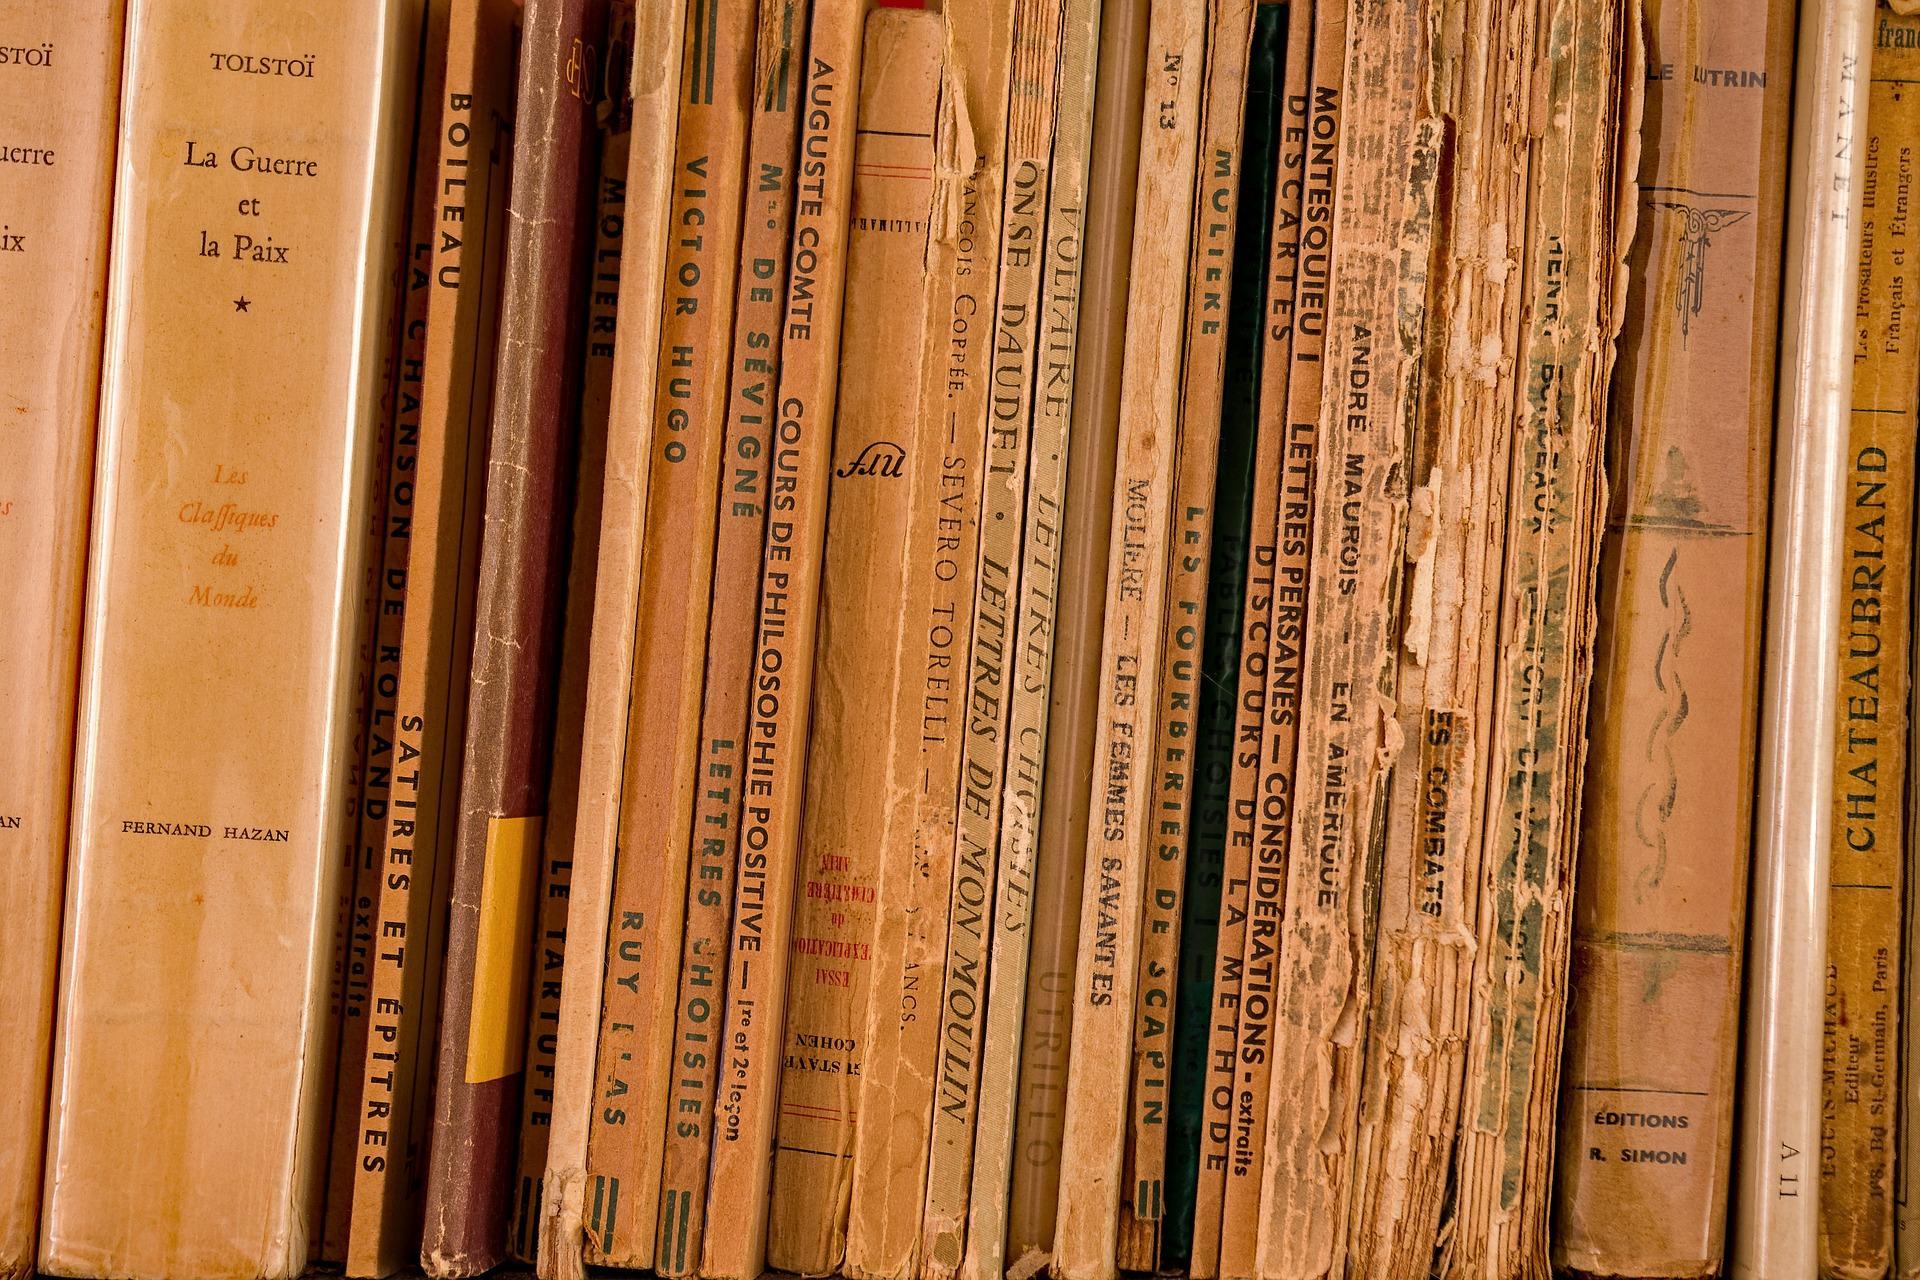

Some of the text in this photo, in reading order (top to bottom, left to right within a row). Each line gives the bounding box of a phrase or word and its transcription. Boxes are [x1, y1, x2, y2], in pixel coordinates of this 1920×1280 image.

[210, 53, 316, 78] TOLSTOÏ
[1647, 63, 1767, 88] LE LUTRIN
[1877, 18, 1920, 48] fran
[184, 141, 318, 177] La Guerre
[1159, 100, 1176, 130] 13
[1831, 53, 1858, 230] MANET
[199, 230, 289, 263] la Paix
[238, 197, 260, 216] et
[438, 93, 473, 289] BOILEAU
[789, 57, 834, 341] AUGUSTE COMTE
[1270, 94, 1309, 342] DESCARTES
[1299, 86, 1339, 336] MONTESQUIEU
[1885, 147, 1912, 355] Français et Étrangers
[411, 243, 432, 292] LA
[664, 156, 708, 464] VICTOR HUGO
[751, 258, 776, 303] DE
[390, 319, 427, 540] CHANSON
[732, 331, 775, 517] SÉVIGNÉ
[989, 303, 1027, 475] DAUDET
[213, 464, 248, 485] Les
[773, 397, 804, 512] COURS
[1282, 423, 1314, 556] LETTRES
[211, 544, 239, 567] du
[769, 522, 793, 562] DE
[935, 456, 966, 582] SEVERO
[1182, 506, 1205, 574] LES
[1338, 453, 1365, 597] MAUROIS
[190, 585, 259, 608] Monde
[383, 568, 407, 617] DE
[970, 555, 1010, 743] LETTRES
[1271, 566, 1305, 727] PERSANES
[1846, 445, 1888, 852] CHATEAUBRIAND
[750, 572, 789, 797] PHILOSOPHIE
[922, 602, 955, 753] TORELLI.
[1112, 654, 1139, 708] LES
[1237, 544, 1276, 770] DISCOURS
[366, 645, 401, 820] ROLAND
[963, 758, 994, 821] DE
[1103, 720, 1134, 843] FEMMES
[1158, 600, 1198, 862] FOURBERIES
[122, 821, 290, 842] FERNAND HAZAN
[698, 739, 734, 908] LETTRES
[739, 807, 771, 952] POSITIVE
[1232, 798, 1256, 848] DE
[1421, 766, 1449, 918] COMBATS
[363, 715, 424, 1173] SATIRES ET ÉPÎTRES
[955, 835, 988, 939] MON
[1089, 857, 1123, 1008] SAVANTES
[1152, 888, 1177, 935] DE
[1225, 877, 1249, 927] LA
[1241, 772, 1287, 1066] CONSIDÉRATIONS
[347, 895, 371, 1019] extraits
[617, 911, 644, 994] RUY
[815, 969, 849, 987] ESSAI
[1871, 947, 1889, 993] Paris
[734, 1032, 752, 1054] et
[796, 1034, 855, 1052] COHEN
[941, 950, 979, 1124] MOULIN
[1025, 972, 1068, 1168] UTRILLO
[1142, 960, 1168, 1125] SCAPIN
[1234, 1090, 1254, 1177] extraits
[1589, 1147, 1687, 1165] R. SIMON
